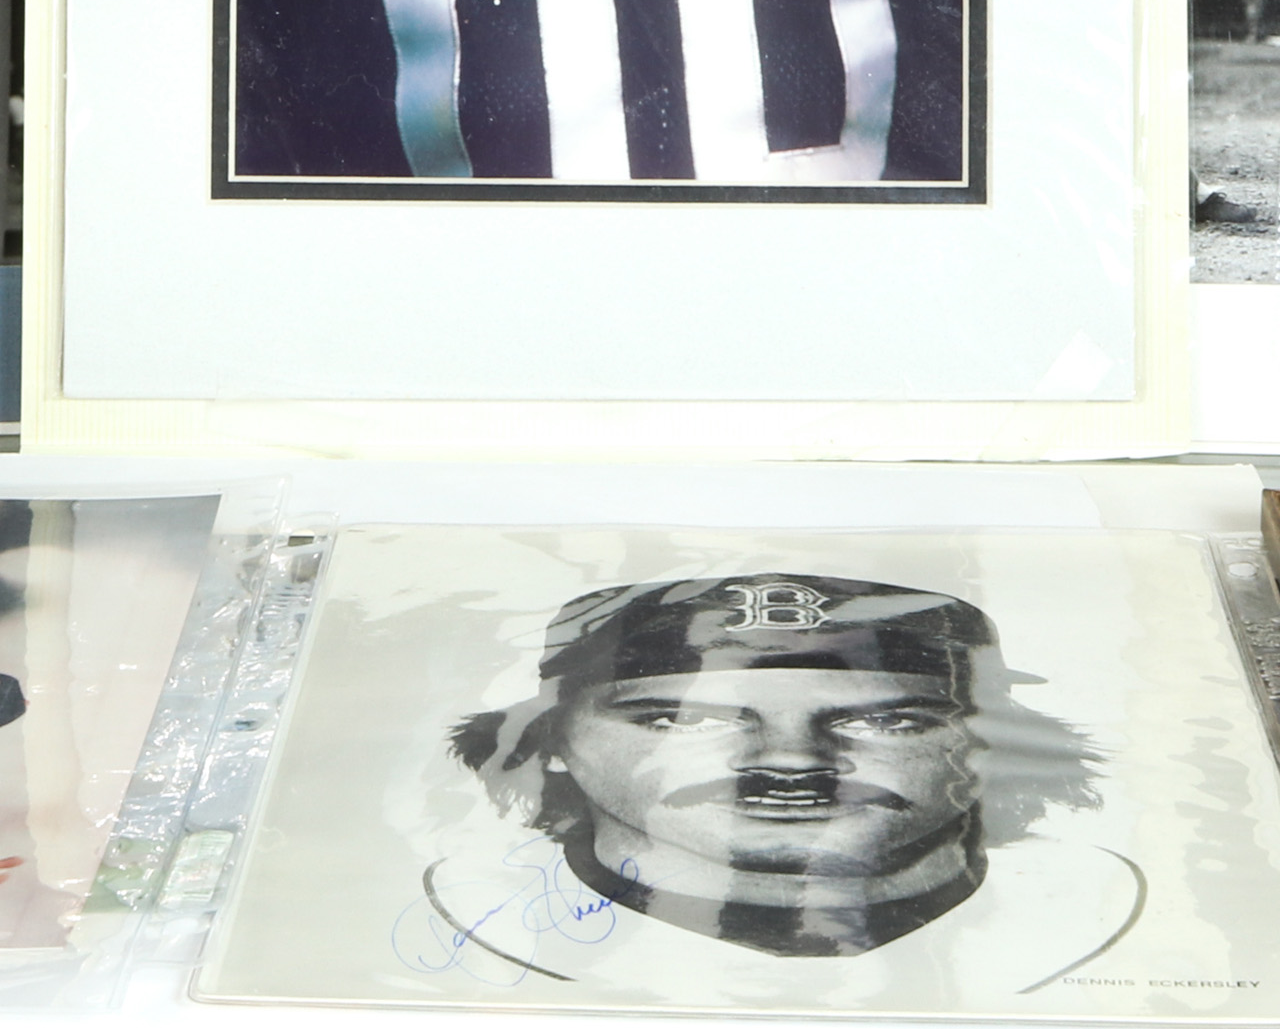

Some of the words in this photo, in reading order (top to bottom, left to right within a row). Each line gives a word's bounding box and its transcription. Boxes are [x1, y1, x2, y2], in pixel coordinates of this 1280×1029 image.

[724, 581, 831, 633] B
[1063, 977, 1136, 986] DENNIS
[1148, 979, 1261, 988] ECKERSLEY
